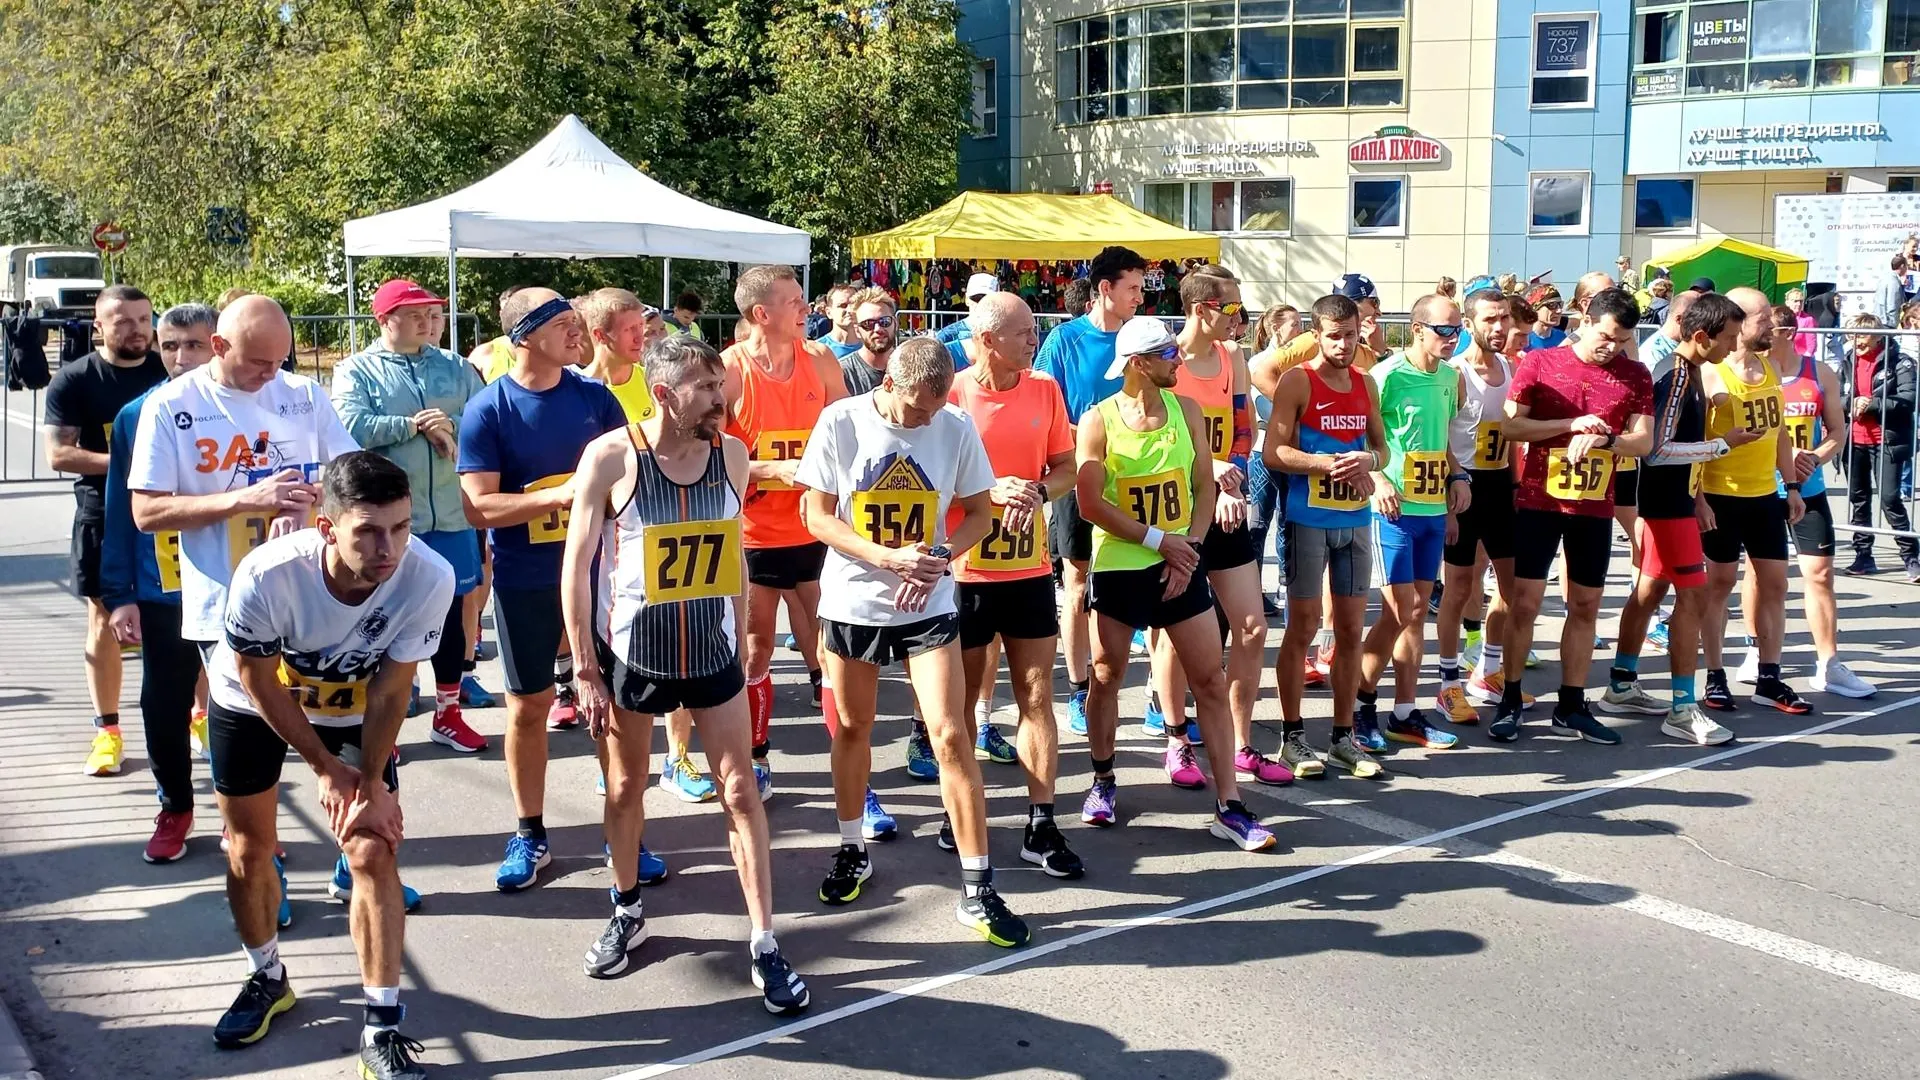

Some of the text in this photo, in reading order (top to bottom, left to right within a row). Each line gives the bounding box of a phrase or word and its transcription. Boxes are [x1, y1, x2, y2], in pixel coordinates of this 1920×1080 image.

[1547, 29, 1579, 37] HOOKAH
[1693, 18, 1747, 36] ЦВЕТЫ
[1546, 54, 1577, 63] LOUNGE
[1548, 37, 1578, 53] 737
[1351, 139, 1439, 161] ПАПА ДЖОНС
[1321, 415, 1367, 430] RUSSIA
[1743, 396, 1780, 432] 338
[1558, 457, 1604, 491] 356
[1128, 480, 1181, 525] 378
[864, 504, 925, 549] 354
[980, 517, 1034, 560] 258
[658, 533, 725, 590] 277
